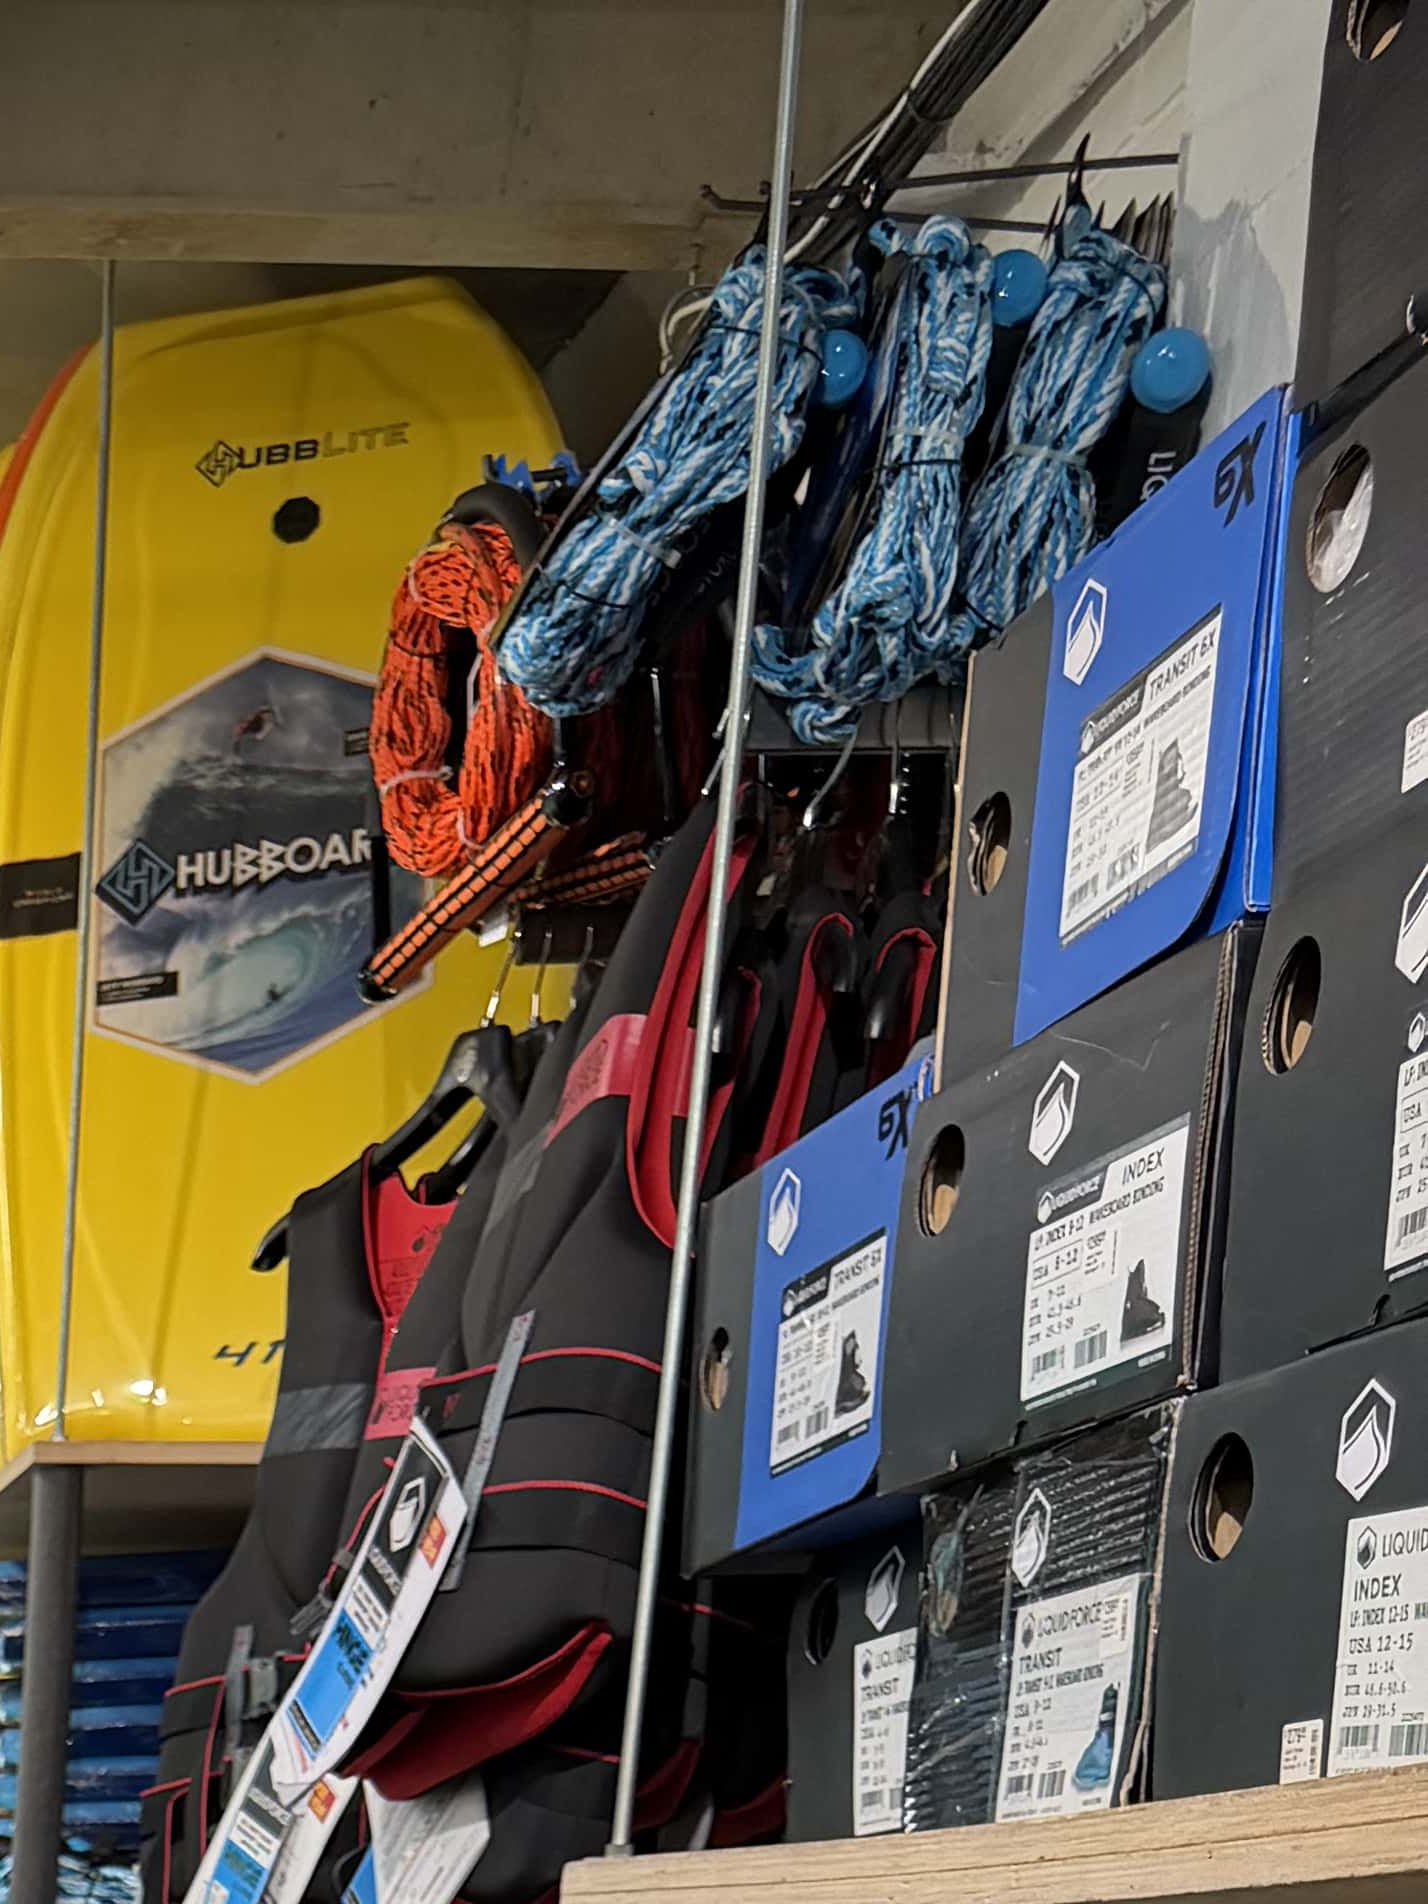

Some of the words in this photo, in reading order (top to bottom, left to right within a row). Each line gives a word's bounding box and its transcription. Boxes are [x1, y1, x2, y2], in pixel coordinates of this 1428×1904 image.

[1121, 1146, 1166, 1186] INDEX
[1352, 1572, 1403, 1602] INDEX
[1348, 1636, 1373, 1655] USA
[1377, 1631, 1415, 1653] 12-15
